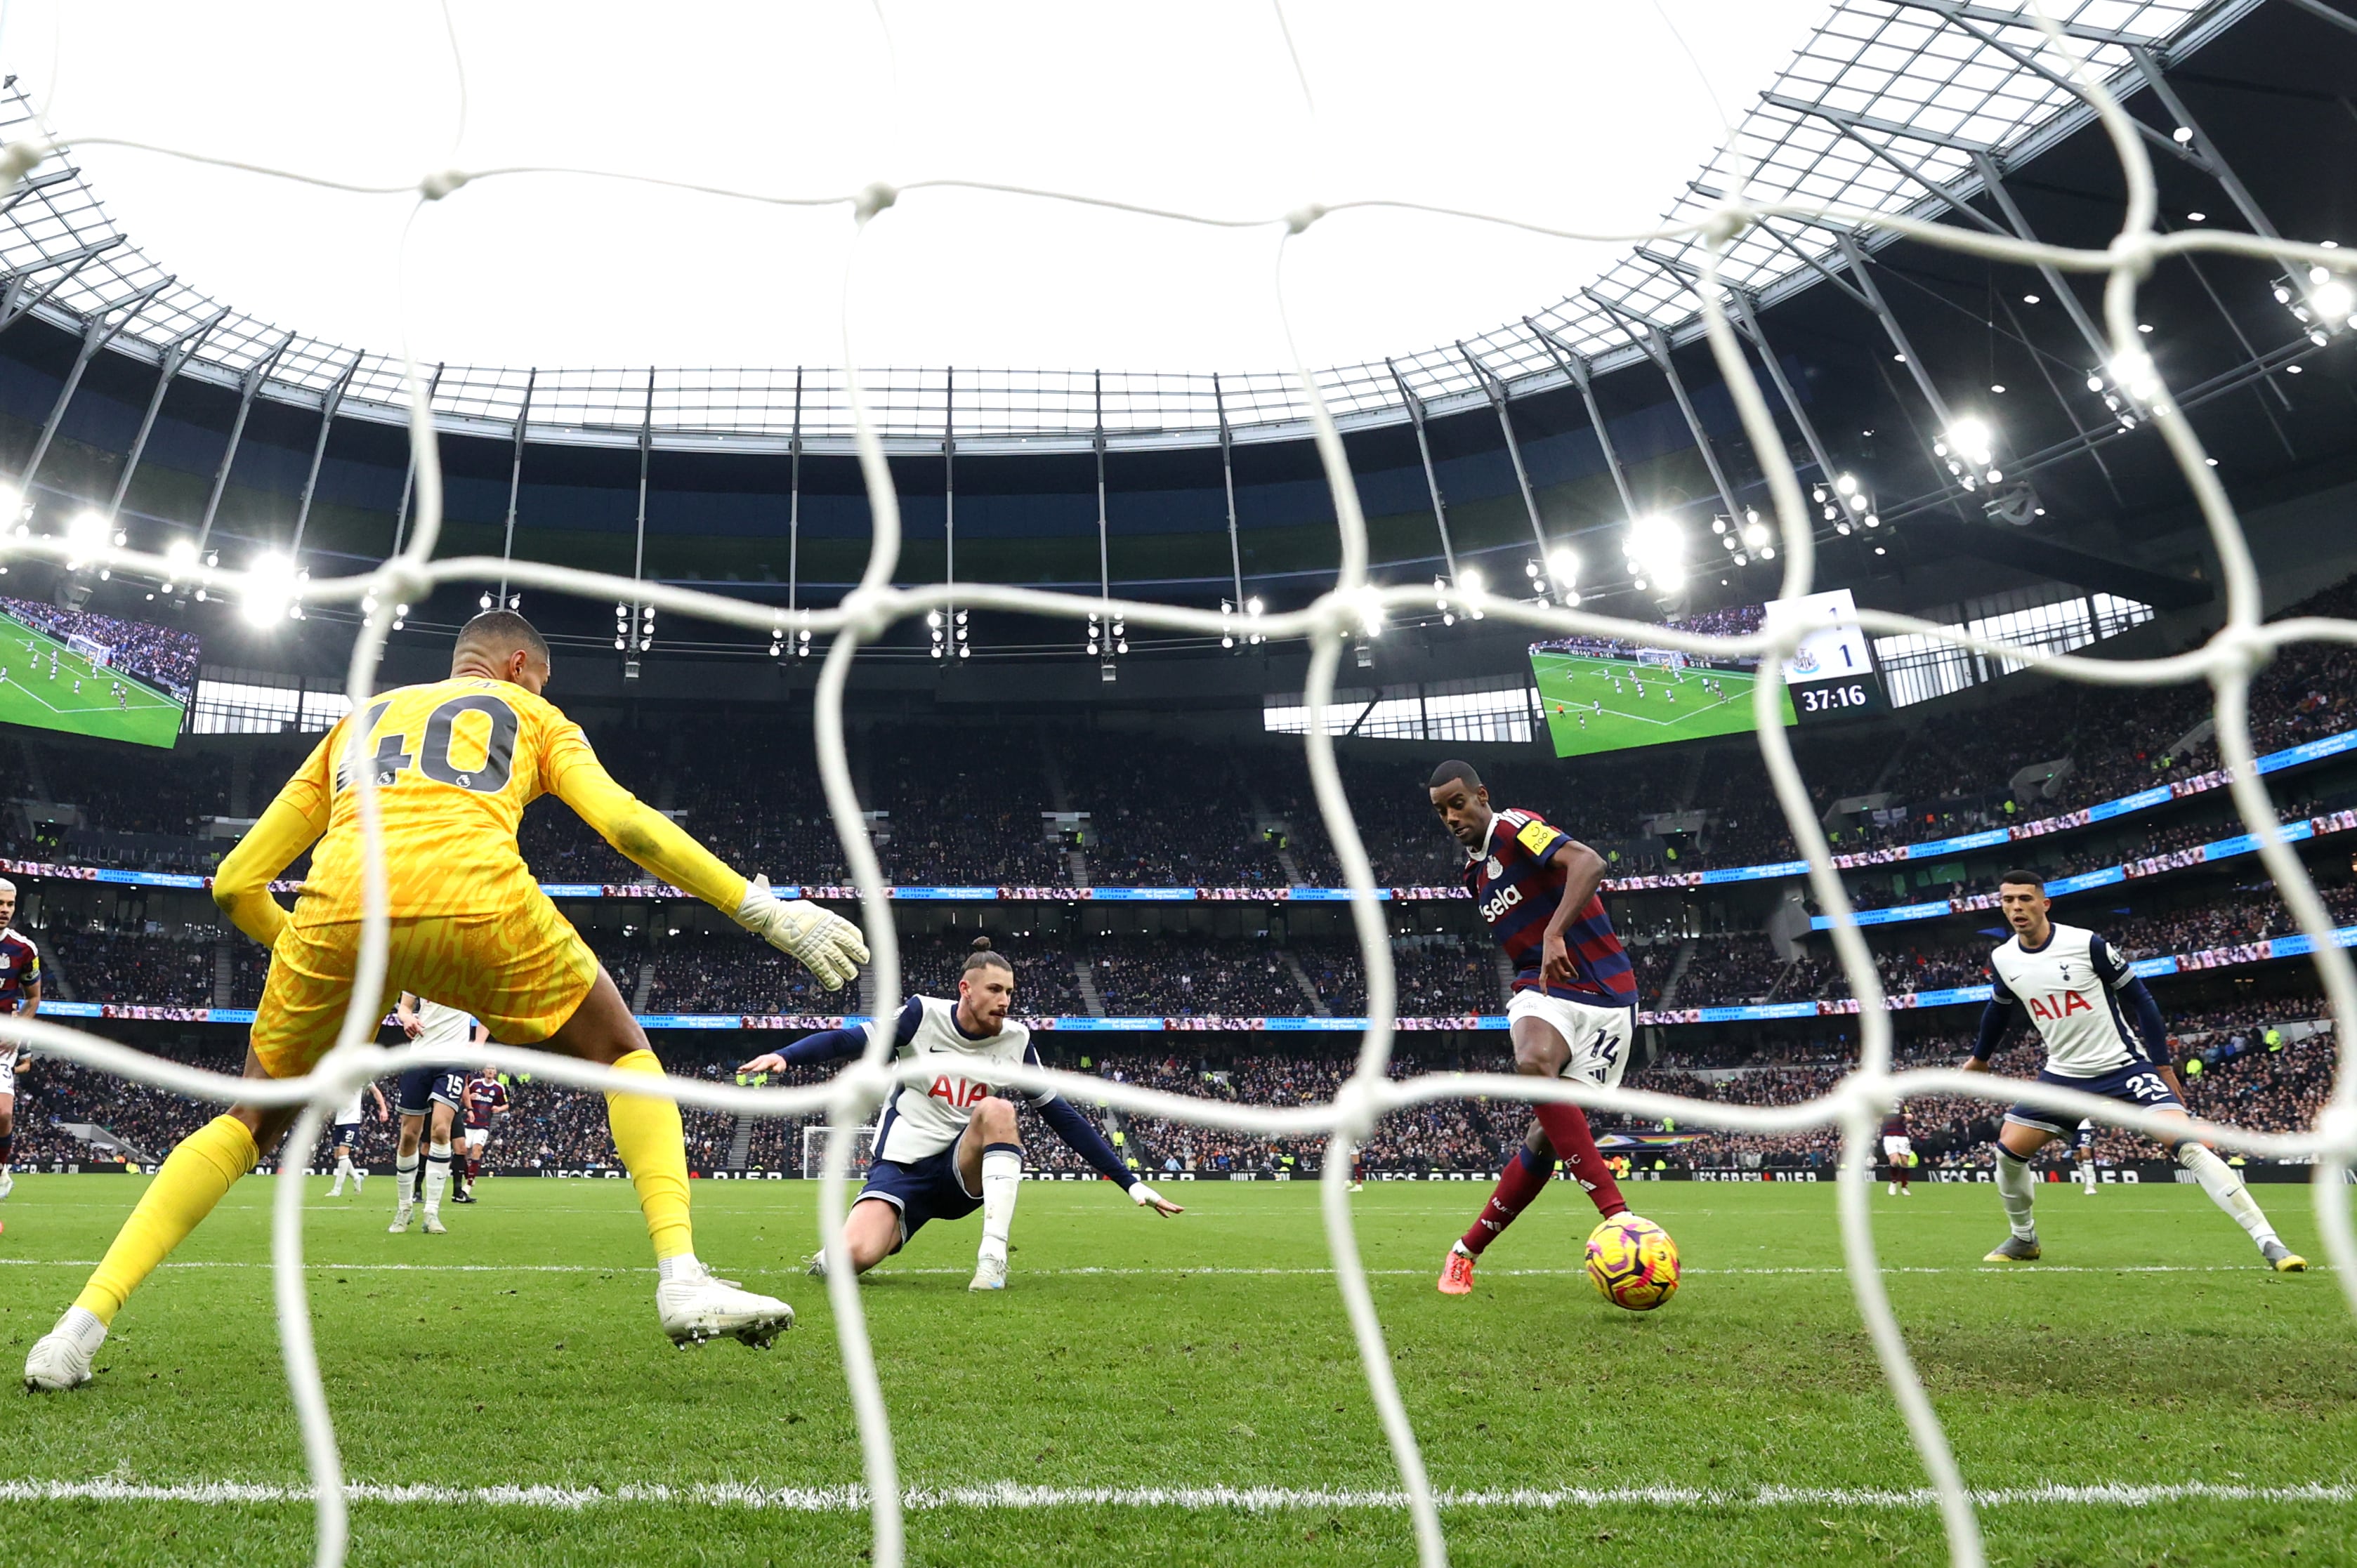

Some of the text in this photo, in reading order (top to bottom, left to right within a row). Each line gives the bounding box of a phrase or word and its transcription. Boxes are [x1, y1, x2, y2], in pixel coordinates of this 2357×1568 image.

[1829, 607, 1842, 631] 1
[1839, 644, 1853, 668] 1
[1801, 685, 1866, 711] 37:16
[337, 694, 518, 793] 40
[1533, 829, 1551, 850] noo
[1483, 883, 1523, 923] sela
[2029, 990, 2093, 1022] AIA
[1590, 1028, 1620, 1069] 14
[446, 1074, 464, 1095] 15
[928, 1074, 987, 1107] AIA
[2125, 1072, 2169, 1099] 23
